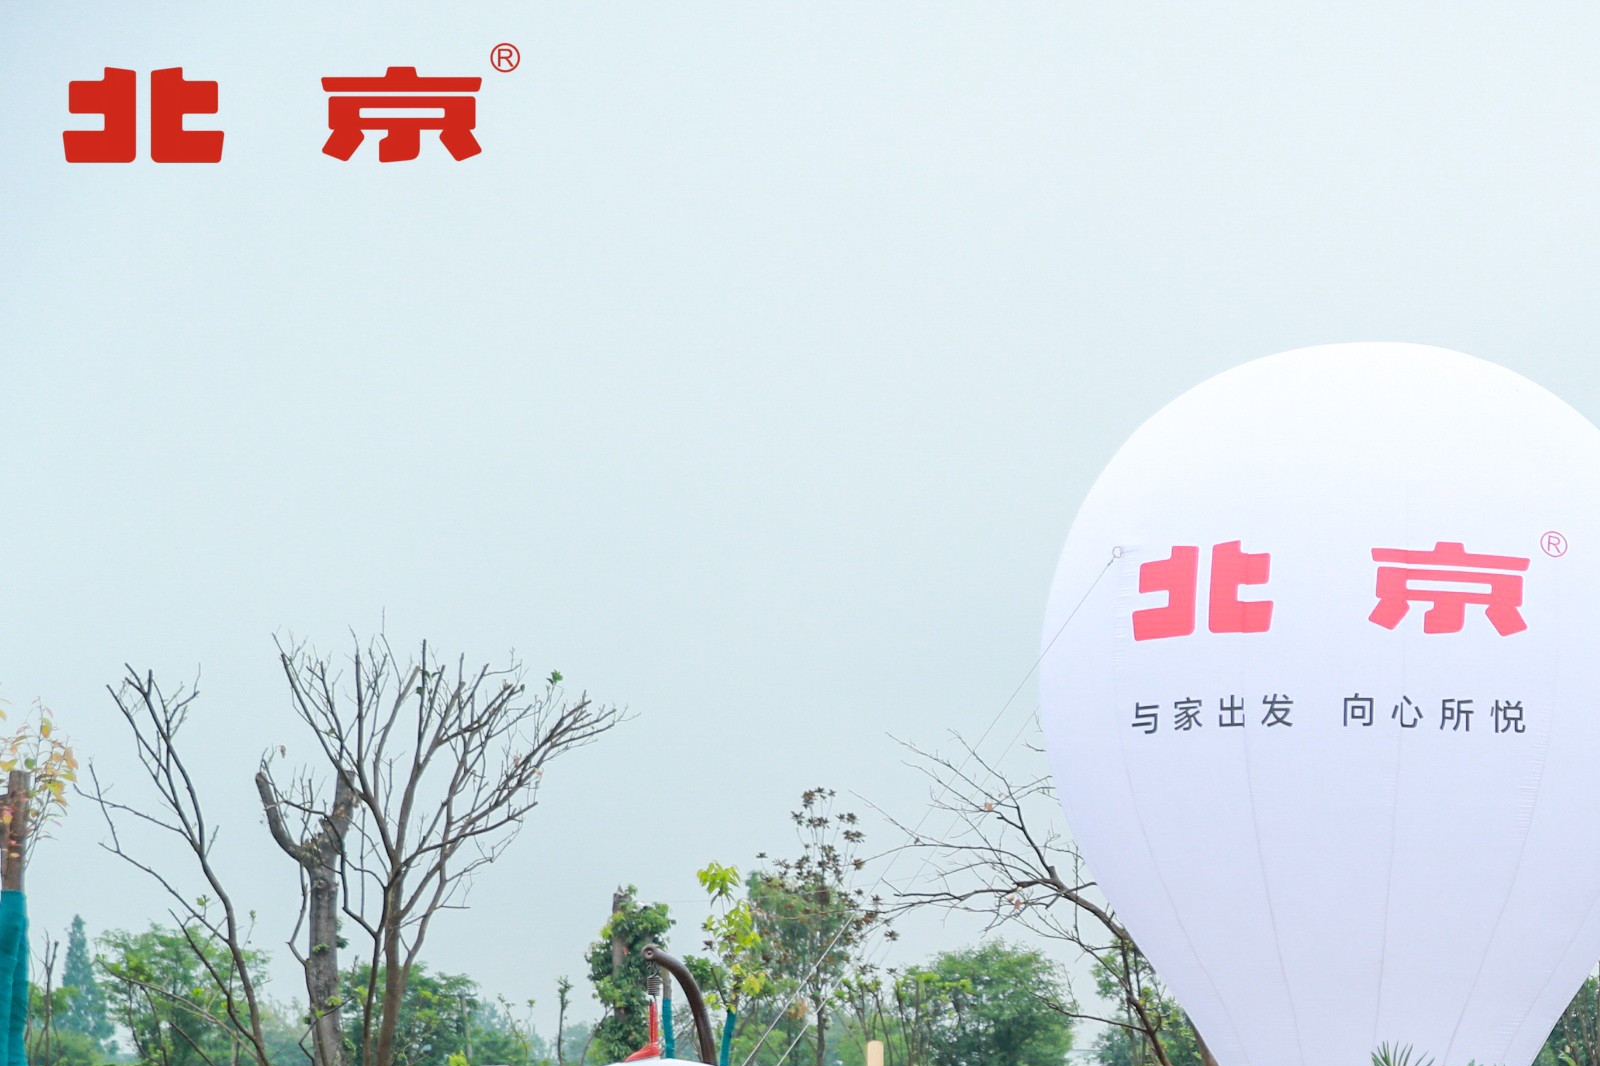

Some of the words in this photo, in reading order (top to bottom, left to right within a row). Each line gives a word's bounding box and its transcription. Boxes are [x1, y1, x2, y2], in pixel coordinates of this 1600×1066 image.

[1132, 540, 1531, 642] 北京
[1131, 692, 1294, 735] 与家出发
[1342, 692, 1526, 734] 向心所悦
